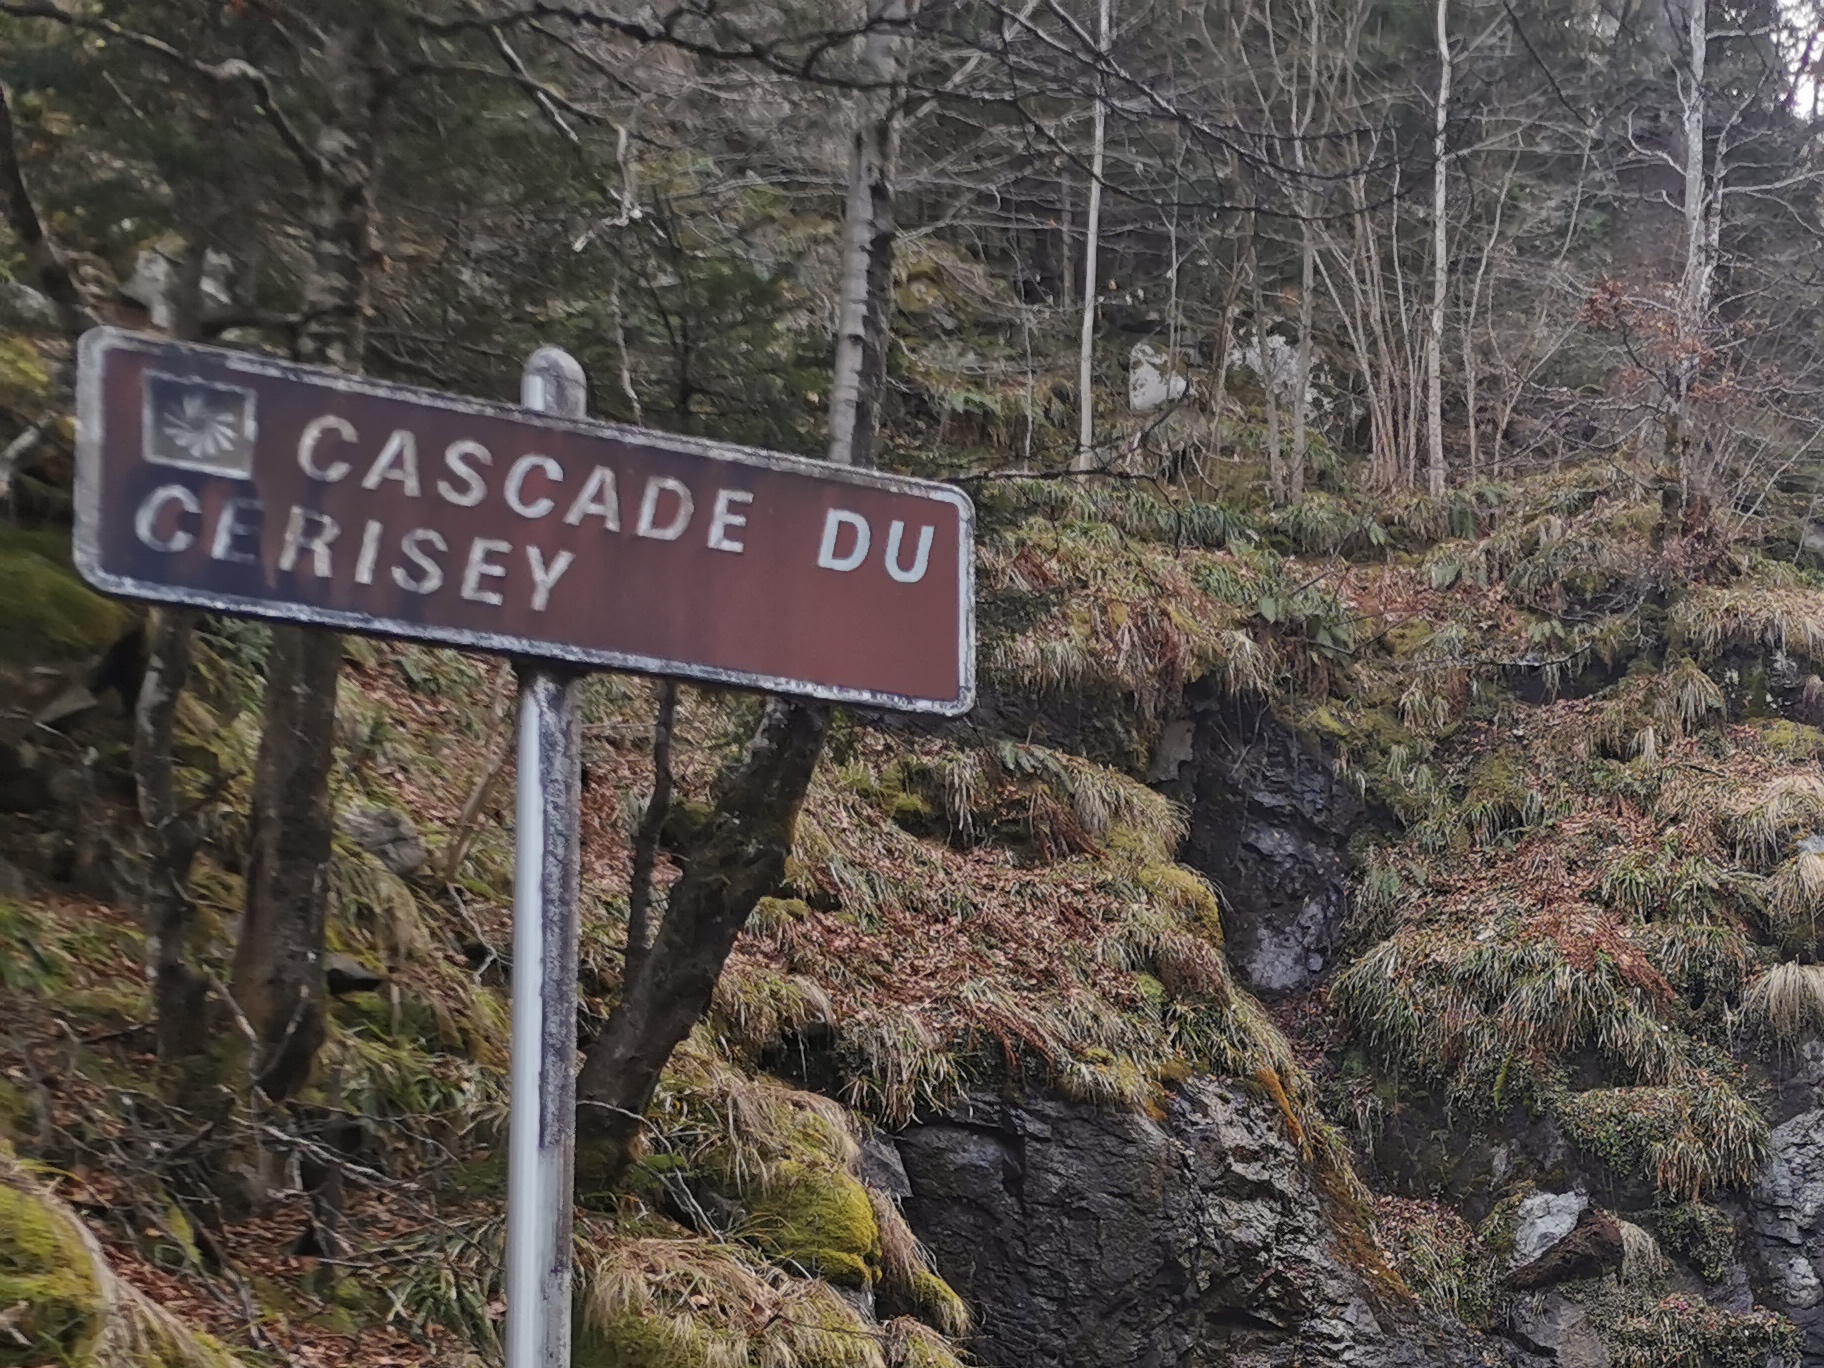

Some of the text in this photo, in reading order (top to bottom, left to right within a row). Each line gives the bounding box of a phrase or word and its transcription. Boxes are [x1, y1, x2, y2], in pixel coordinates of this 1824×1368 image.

[134, 484, 575, 612] CERISEY
[297, 413, 935, 584] CASCADE DU
